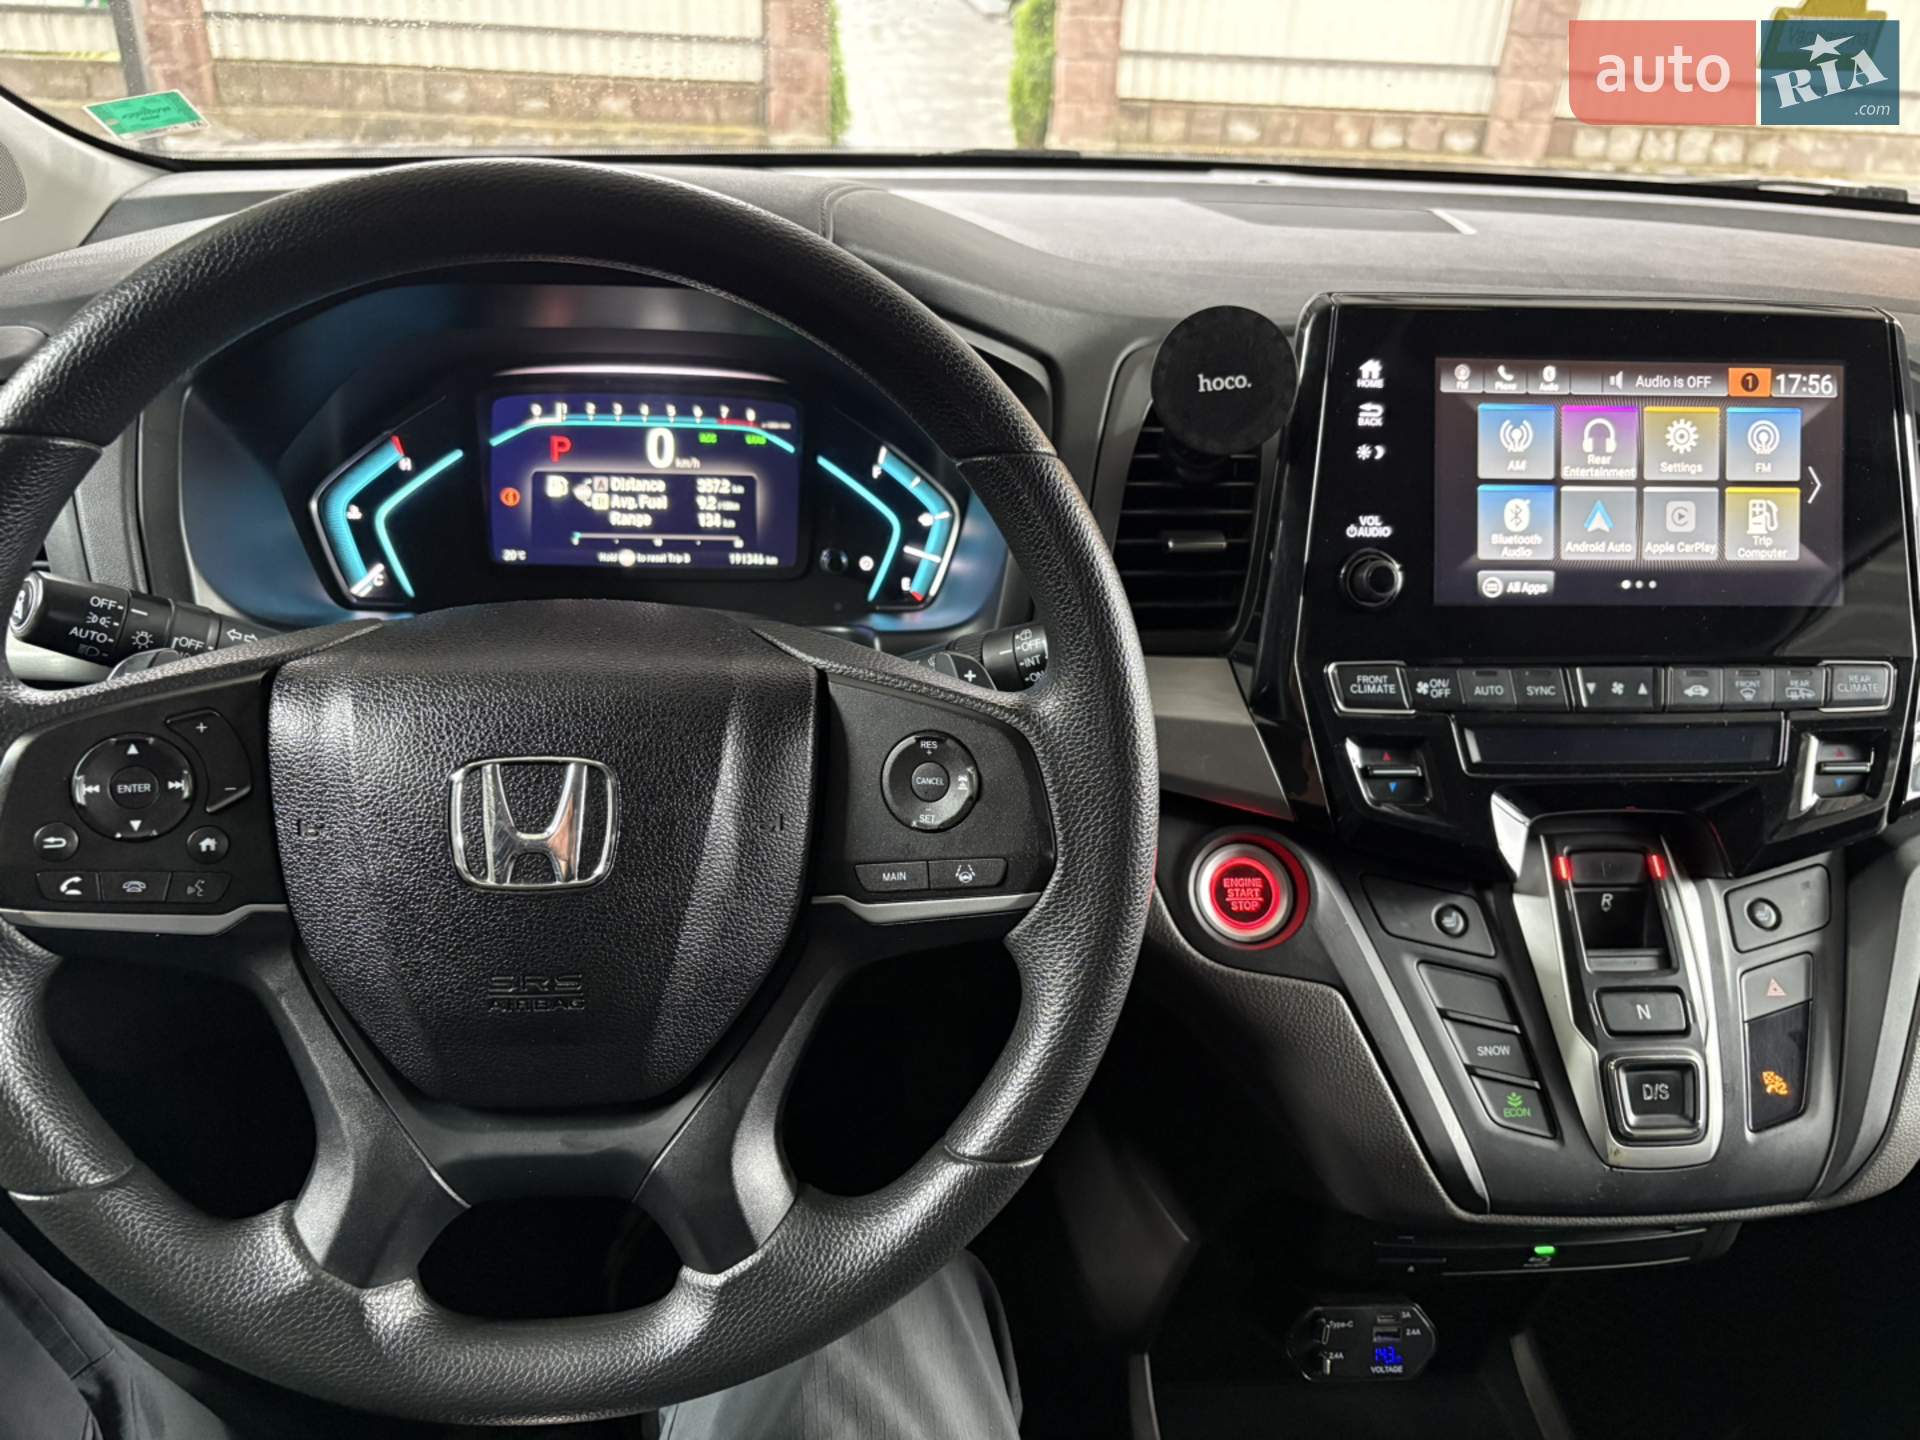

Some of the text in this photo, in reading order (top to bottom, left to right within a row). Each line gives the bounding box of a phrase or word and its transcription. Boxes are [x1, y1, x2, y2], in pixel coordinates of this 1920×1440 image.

[1197, 373, 1252, 393] hoco.
[1356, 378, 1385, 389] HOME
[1636, 375, 1712, 389] Audio is OFF
[1775, 373, 1834, 395] 17:56
[1357, 416, 1383, 427] BACK
[551, 435, 572, 462] P
[646, 427, 701, 469] 0 km/h
[1507, 459, 1527, 471] AM
[1587, 454, 1612, 465] Rear
[1563, 466, 1635, 479] Entertainment
[1660, 461, 1703, 475] Settings
[1755, 463, 1772, 473] FM
[610, 475, 666, 492] Distance
[610, 494, 638, 511] Avg.
[638, 494, 668, 510] Fuel
[609, 510, 653, 528] Range
[1359, 515, 1382, 526] VOL
[1357, 526, 1391, 538] AUDIO
[1491, 534, 1543, 545] Bluetooth
[1752, 535, 1773, 547] Trip
[1501, 546, 1533, 558] Audio
[1565, 541, 1632, 553] Android Auto
[1645, 541, 1717, 556] Apple CarPlay
[1737, 547, 1788, 560] Computer
[1506, 581, 1549, 595] All Apps
[90, 596, 118, 610] OFF
[69, 627, 108, 643] AUTO
[1020, 638, 1041, 652] OFF
[1024, 654, 1041, 667] INT
[1356, 675, 1388, 684] FRONT
[1735, 679, 1761, 689] FRONT
[1848, 674, 1872, 684] REAR
[1350, 683, 1396, 695] CLIMATE
[1430, 688, 1451, 699] OFF
[1473, 685, 1504, 696] AUTO
[1526, 685, 1556, 697] SYNC
[1837, 682, 1880, 694] CLIMATE
[920, 740, 938, 749] RES
[916, 776, 945, 786] CANCEL
[117, 783, 151, 794] ENTER
[919, 814, 936, 824] SET
[882, 872, 907, 882] MAIN
[1223, 878, 1263, 888] ENGINE
[1227, 888, 1260, 898] START
[1231, 901, 1259, 911] STOP
[1601, 893, 1613, 907] R
[487, 974, 583, 993] SRS
[1636, 1004, 1652, 1020] N
[1477, 1045, 1511, 1056] SNOW
[1642, 1084, 1670, 1101] D/S
[1503, 1106, 1531, 1118] ECON
[1329, 1320, 1354, 1329] Type-C
[1370, 1365, 1404, 1374] VOLTAGE
